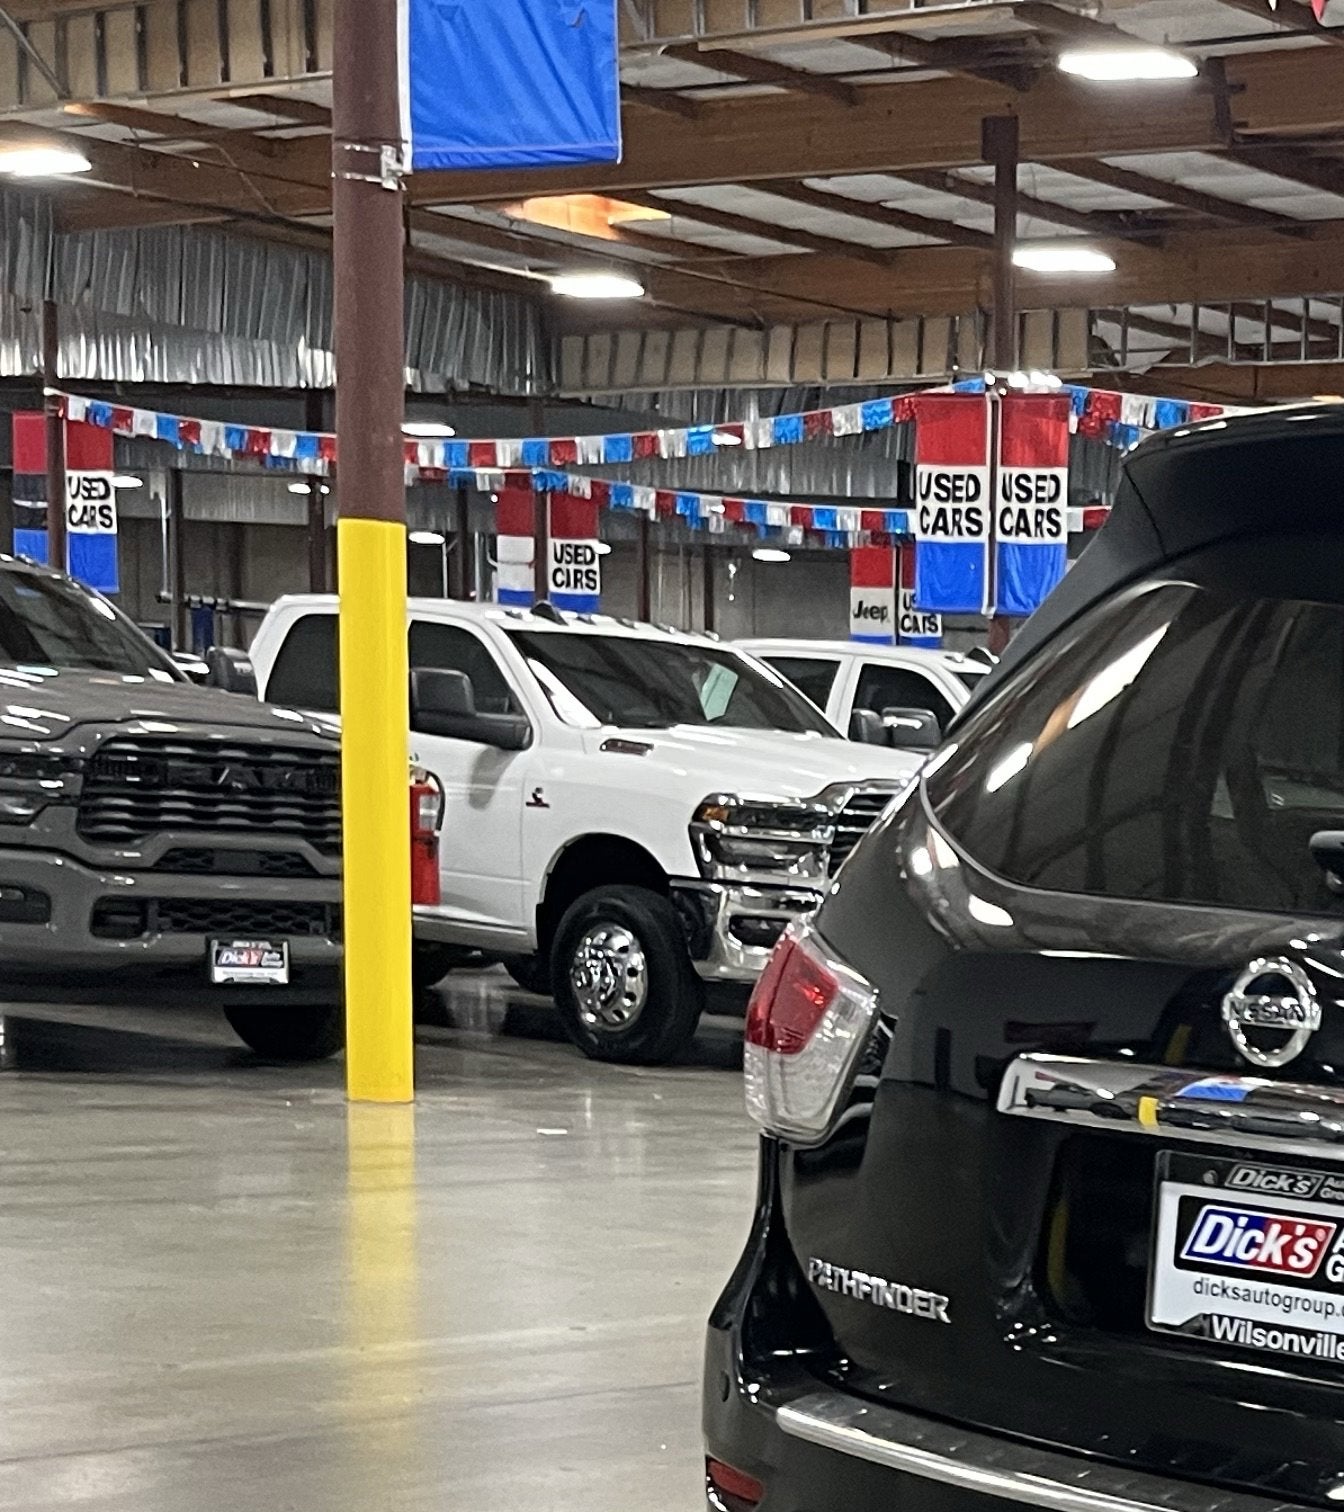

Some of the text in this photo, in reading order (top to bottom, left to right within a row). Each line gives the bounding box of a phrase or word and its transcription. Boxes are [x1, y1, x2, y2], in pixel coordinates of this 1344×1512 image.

[68, 476, 111, 500] USED
[919, 472, 981, 503] USED
[1001, 473, 1061, 503] USED
[919, 505, 983, 537] CARS
[1000, 506, 1062, 538] CARS
[553, 542, 596, 566] USED
[853, 600, 888, 625] Jeep
[1231, 1168, 1314, 1195] Dick's
[1191, 1212, 1320, 1270] Dick's
[807, 1256, 953, 1325] PATHFINDER
